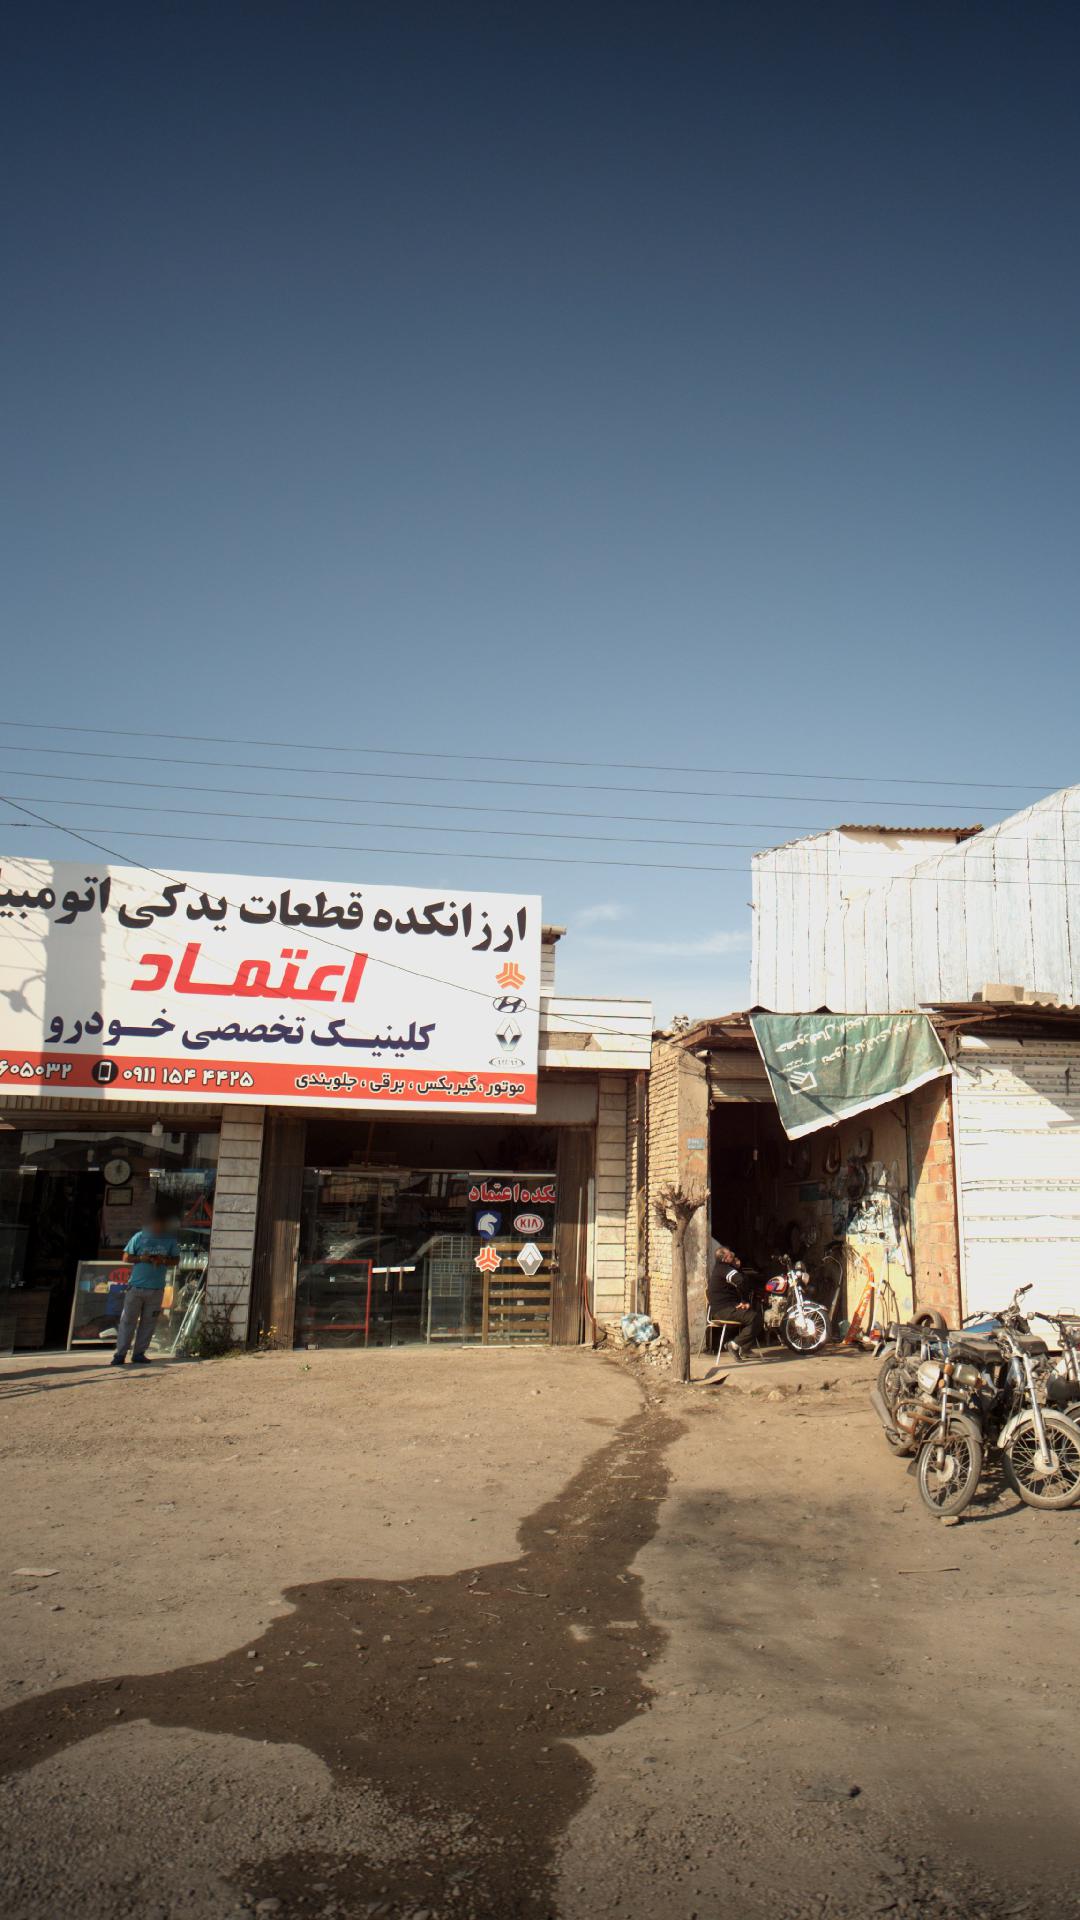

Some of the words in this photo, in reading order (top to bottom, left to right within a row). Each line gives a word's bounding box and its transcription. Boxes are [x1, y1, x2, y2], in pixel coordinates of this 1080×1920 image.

[0, 869, 111, 925] اتومبی
[118, 882, 229, 932] یدکی
[239, 890, 364, 930] قطعات
[373, 900, 528, 952] ارزانکده
[131, 942, 369, 1003] اعتماد
[45, 1008, 176, 1046] خودرو
[181, 1014, 305, 1050] تخصصی
[310, 1018, 436, 1059] کلینیک
[122, 1066, 156, 1083] ۰۹۱۱
[162, 1067, 197, 1085] ۱۵۴
[201, 1069, 255, 1087] ۴۴۲۵
[295, 1072, 357, 1091] جلوبندی
[469, 1182, 520, 1203] اعتماد
[519, 1218, 539, 1228] KIA
